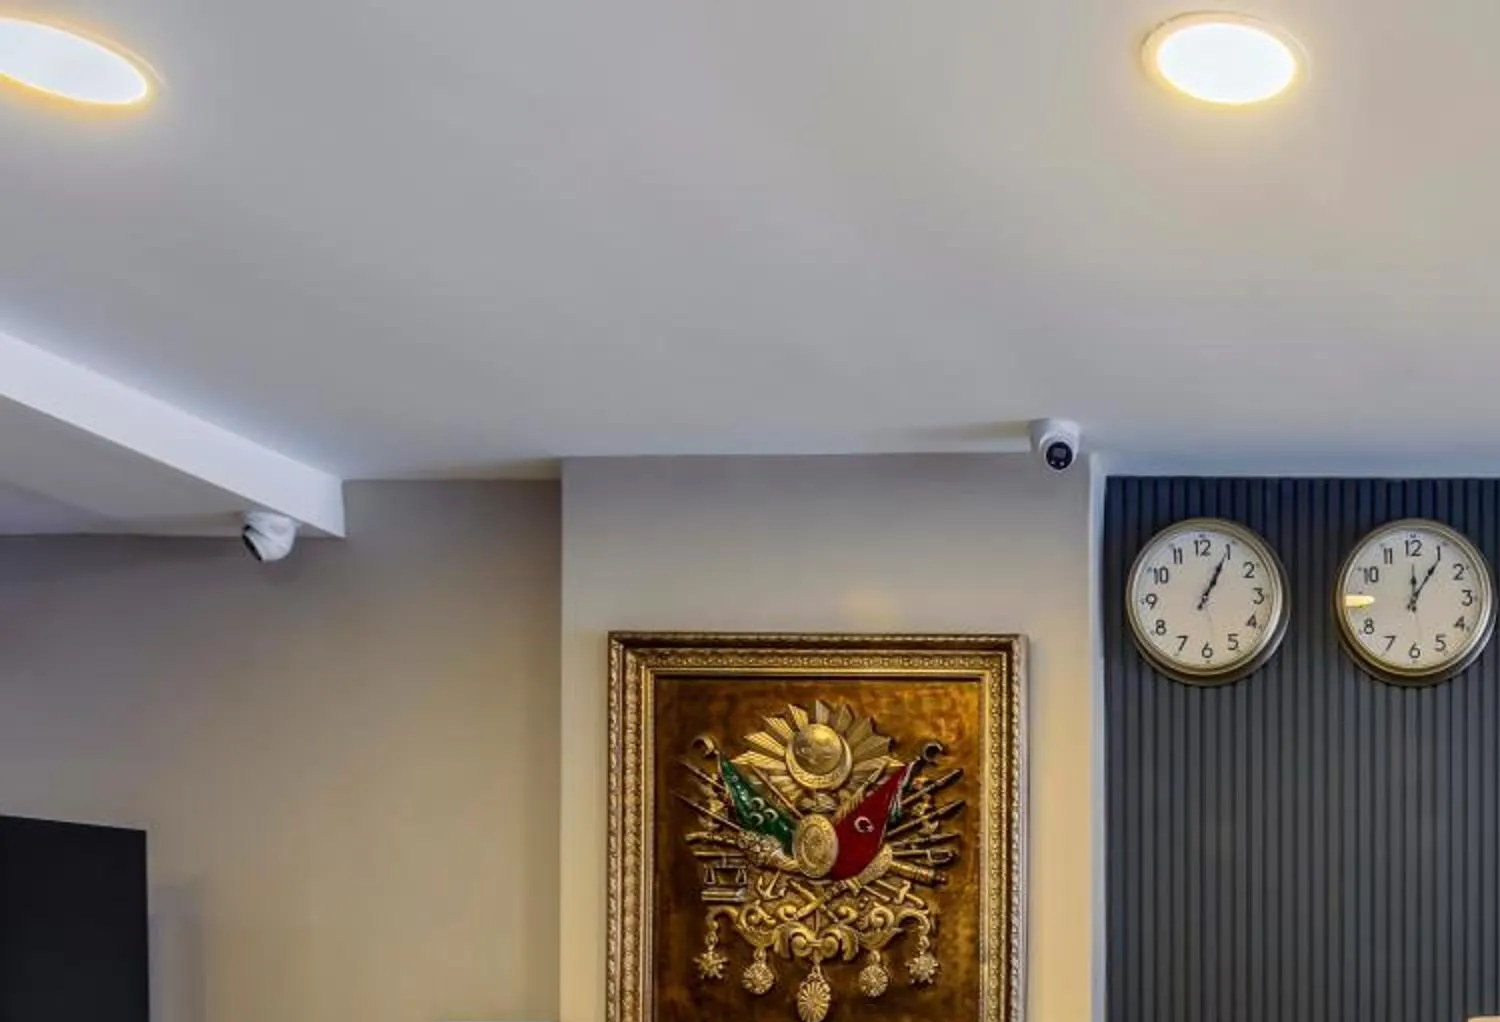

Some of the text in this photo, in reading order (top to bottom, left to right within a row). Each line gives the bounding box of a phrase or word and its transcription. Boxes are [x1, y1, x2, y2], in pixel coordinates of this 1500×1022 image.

[1173, 548, 1183, 564] 11
[1194, 540, 1211, 556] 12
[1225, 544, 1230, 560] 1
[1383, 548, 1393, 564] 11
[1405, 540, 1422, 557] 12
[1153, 567, 1168, 584] 10
[1243, 562, 1255, 578] 2
[1364, 567, 1378, 584] 10
[1453, 564, 1464, 580] 2
[1146, 593, 1157, 609] 9
[1253, 588, 1264, 604] 3
[1462, 590, 1472, 606] 3
[1156, 620, 1166, 635] 8
[1246, 614, 1256, 628] 4
[1364, 619, 1375, 634] 8
[1454, 616, 1465, 631] 4
[1177, 635, 1188, 651] 7
[1201, 642, 1212, 658] 6
[1228, 634, 1239, 650] 5
[1384, 636, 1395, 651] 7
[1435, 634, 1446, 651] 5
[1409, 643, 1420, 658] 6
